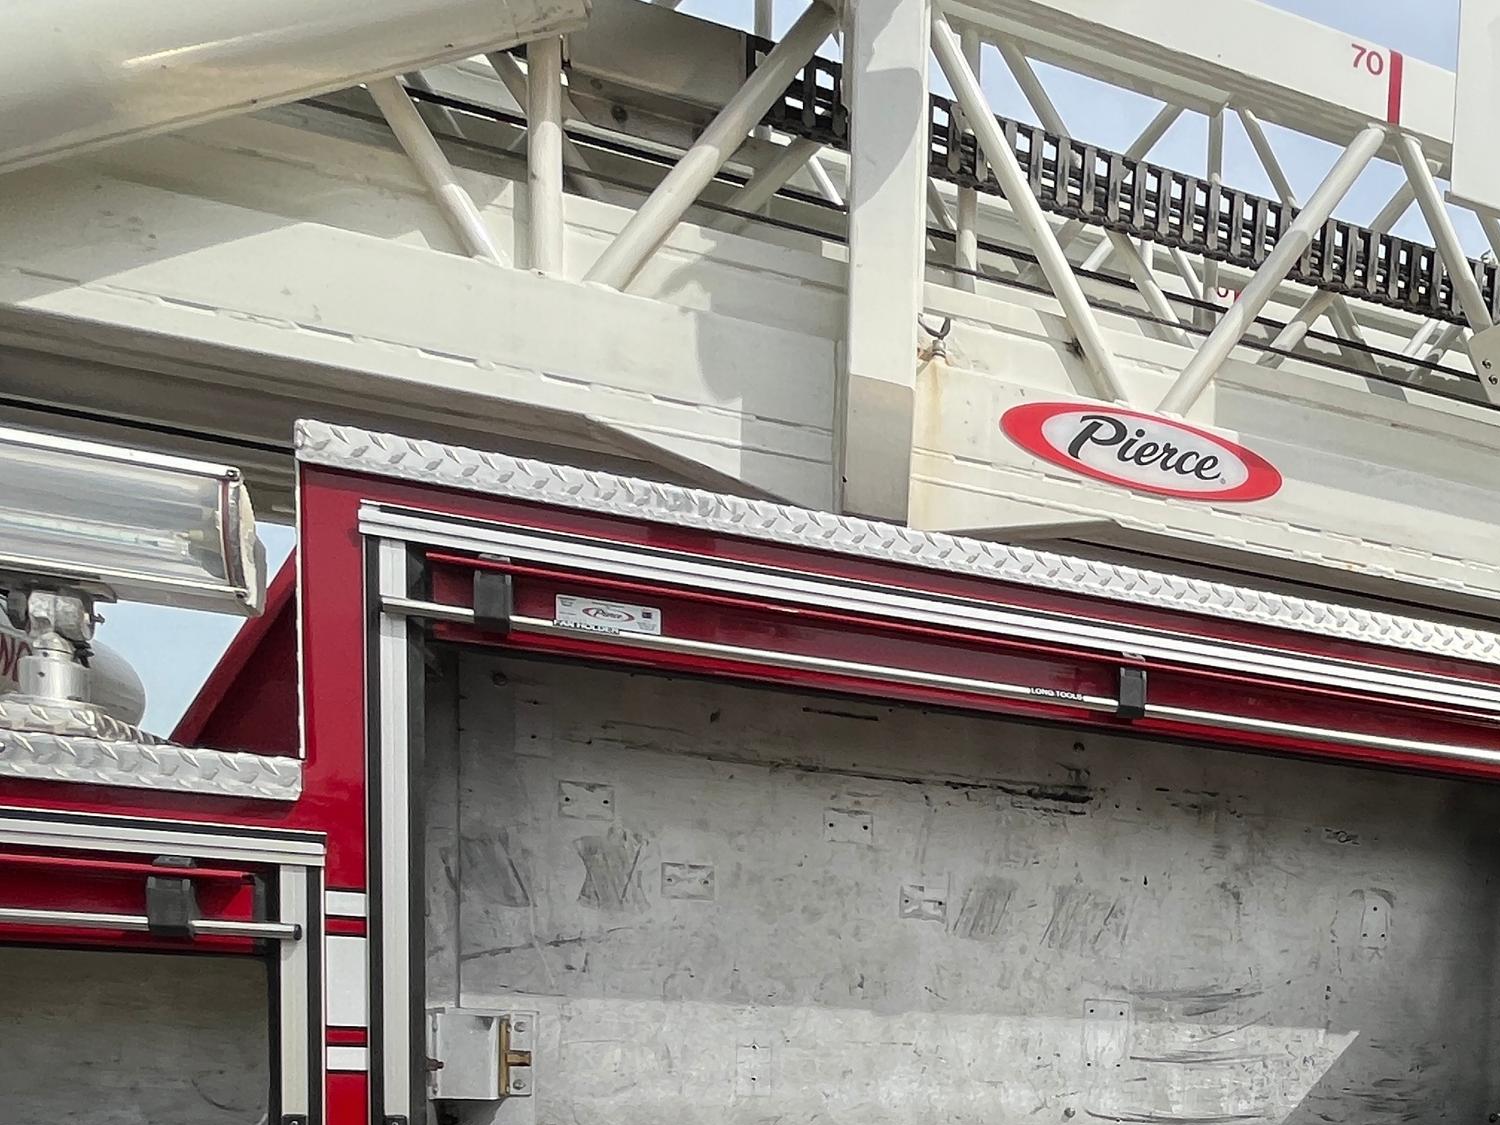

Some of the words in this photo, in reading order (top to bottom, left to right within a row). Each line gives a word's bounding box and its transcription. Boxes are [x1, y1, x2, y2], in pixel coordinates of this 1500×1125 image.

[1351, 43, 1384, 76] 70
[1067, 414, 1222, 481] Pierce
[1031, 687, 1055, 697] LONG
[1056, 690, 1083, 701] TOOLS
